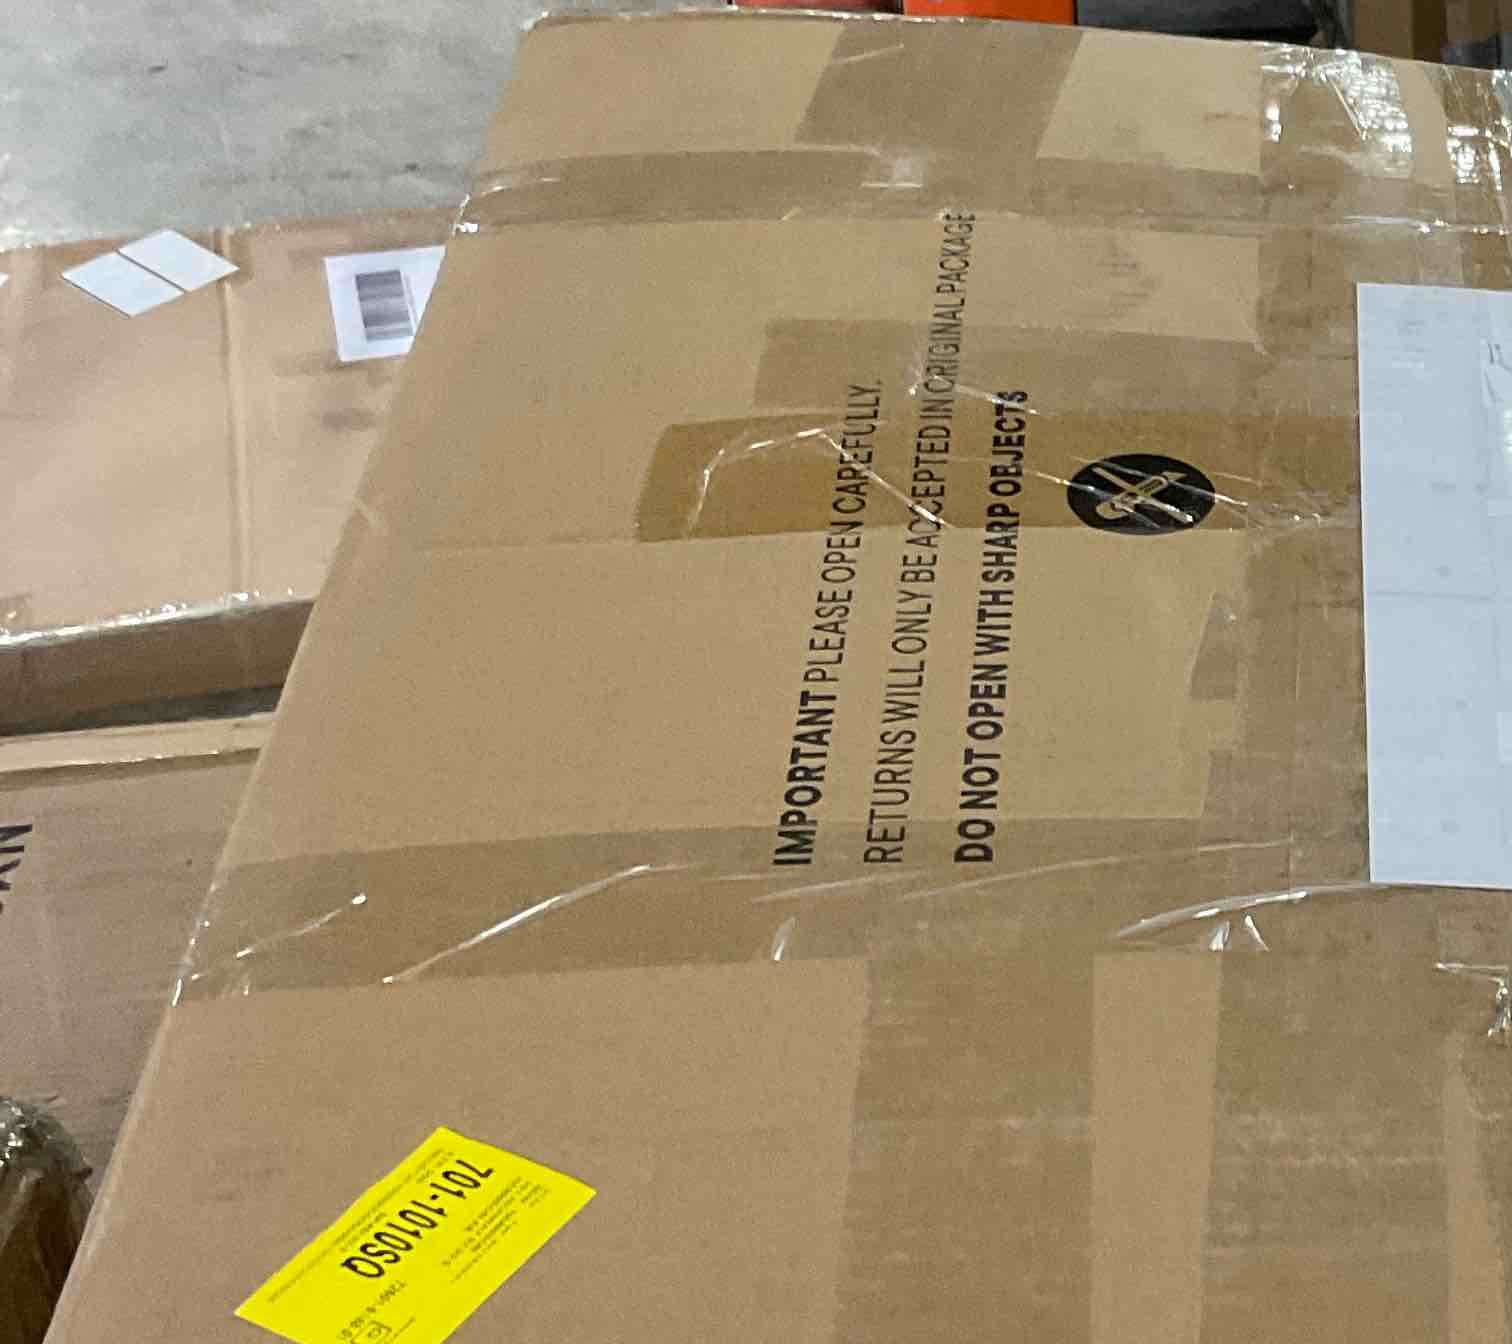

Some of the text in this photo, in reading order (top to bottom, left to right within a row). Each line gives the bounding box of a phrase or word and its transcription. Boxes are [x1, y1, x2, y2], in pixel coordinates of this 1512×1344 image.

[935, 211, 977, 295] PACKAGE
[922, 297, 967, 394] ORIGINAL
[906, 423, 952, 548] ACCEPTED
[821, 521, 865, 583] OPEN
[900, 554, 939, 584] BE
[803, 589, 854, 683] PLEASE
[891, 589, 934, 654] ONLY
[953, 390, 1029, 863] DO NOT OPEN WITH SHARP OBJECTS
[880, 659, 926, 724] WILL
[773, 690, 838, 866] IMPORTANT
[863, 729, 918, 863] RETURNS
[340, 1159, 495, 1280] 701-1010SQ
